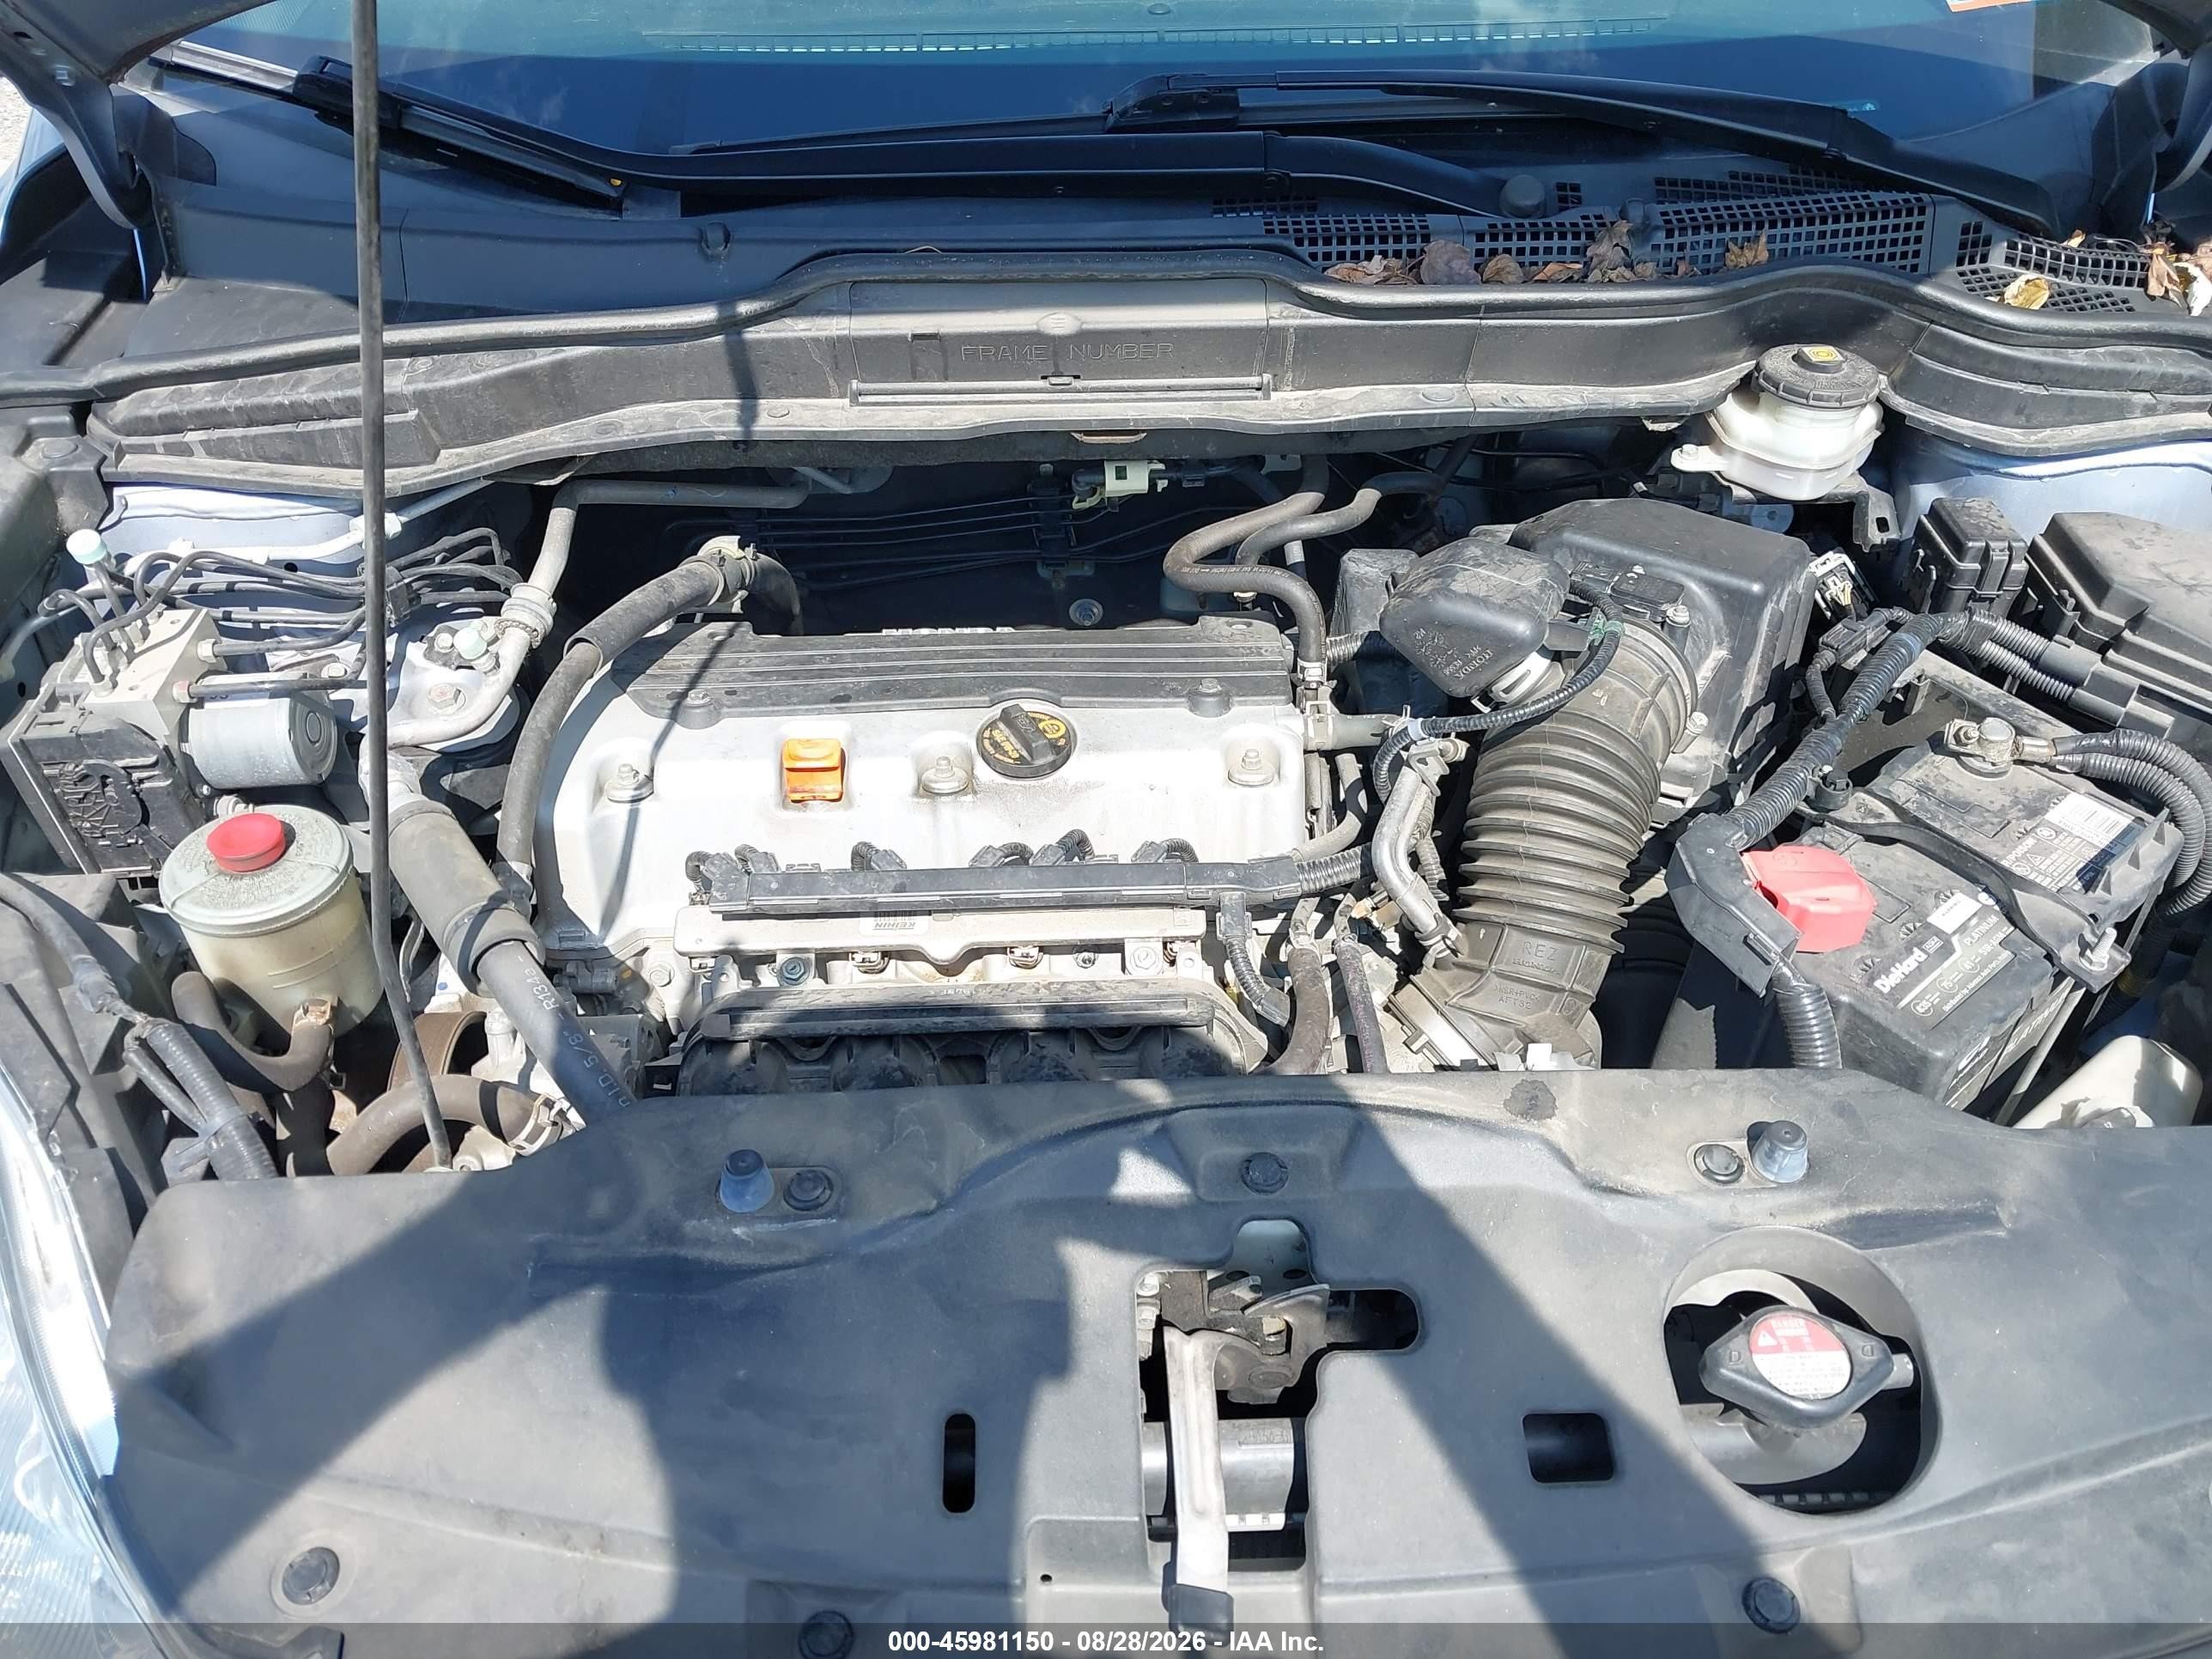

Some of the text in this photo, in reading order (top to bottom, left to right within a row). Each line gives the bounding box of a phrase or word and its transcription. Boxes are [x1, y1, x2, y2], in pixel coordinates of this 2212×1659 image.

[961, 343, 1174, 362] FRAME NUMBER
[992, 729, 1006, 744] SAE
[1964, 914, 2000, 946] PLATINUM
[1522, 940, 1559, 962] REZ
[1874, 946, 1929, 994] DieHard
[525, 968, 560, 1012] R134a
[1941, 981, 1953, 990] 75
